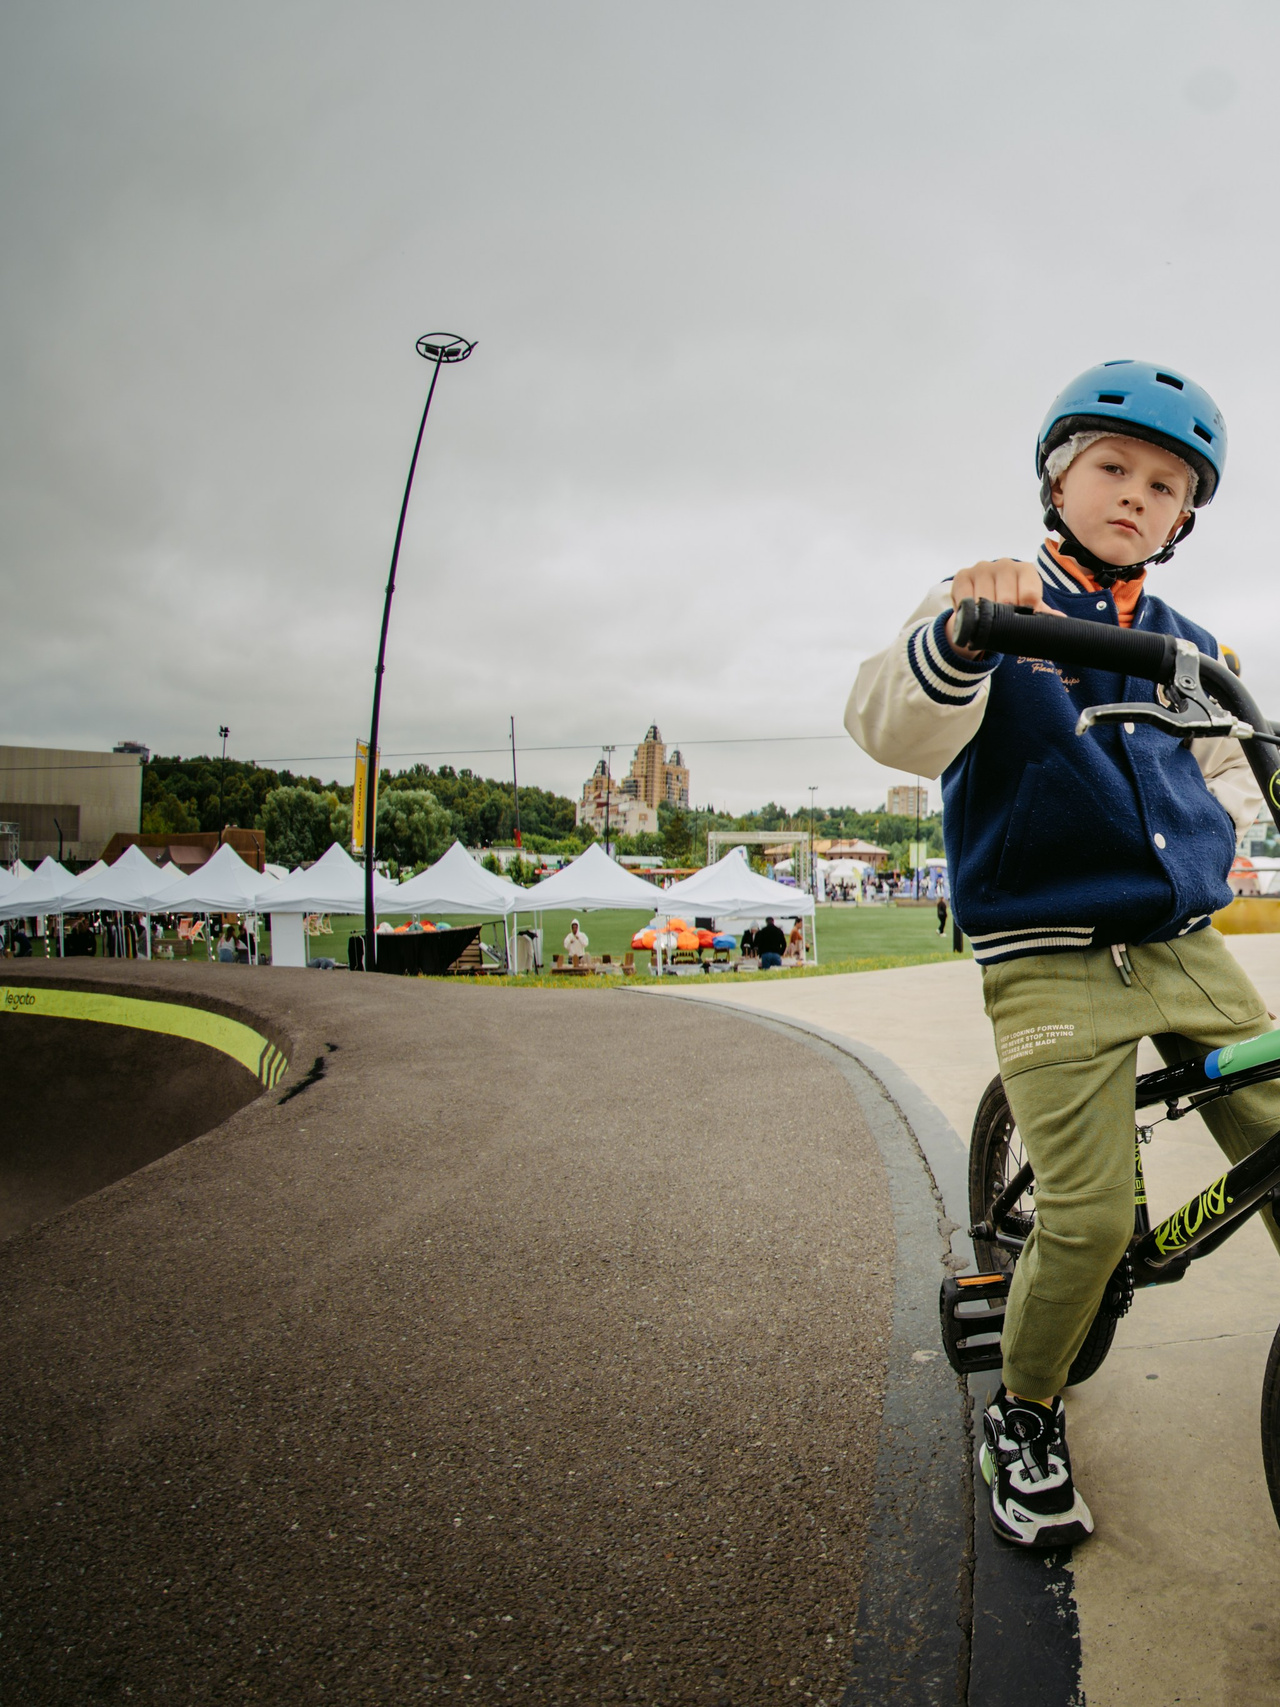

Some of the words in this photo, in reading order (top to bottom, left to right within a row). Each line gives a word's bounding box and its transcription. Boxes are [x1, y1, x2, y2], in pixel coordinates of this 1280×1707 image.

[5, 989, 36, 1010] legato
[1008, 1037, 1025, 1047] NEVER
[1025, 1033, 1044, 1042] STOP
[1046, 1030, 1074, 1038] TRYING
[1010, 1027, 1035, 1039] LOOKING
[1037, 1024, 1075, 1032] FORWARD
[1035, 1038, 1057, 1047] MADE
